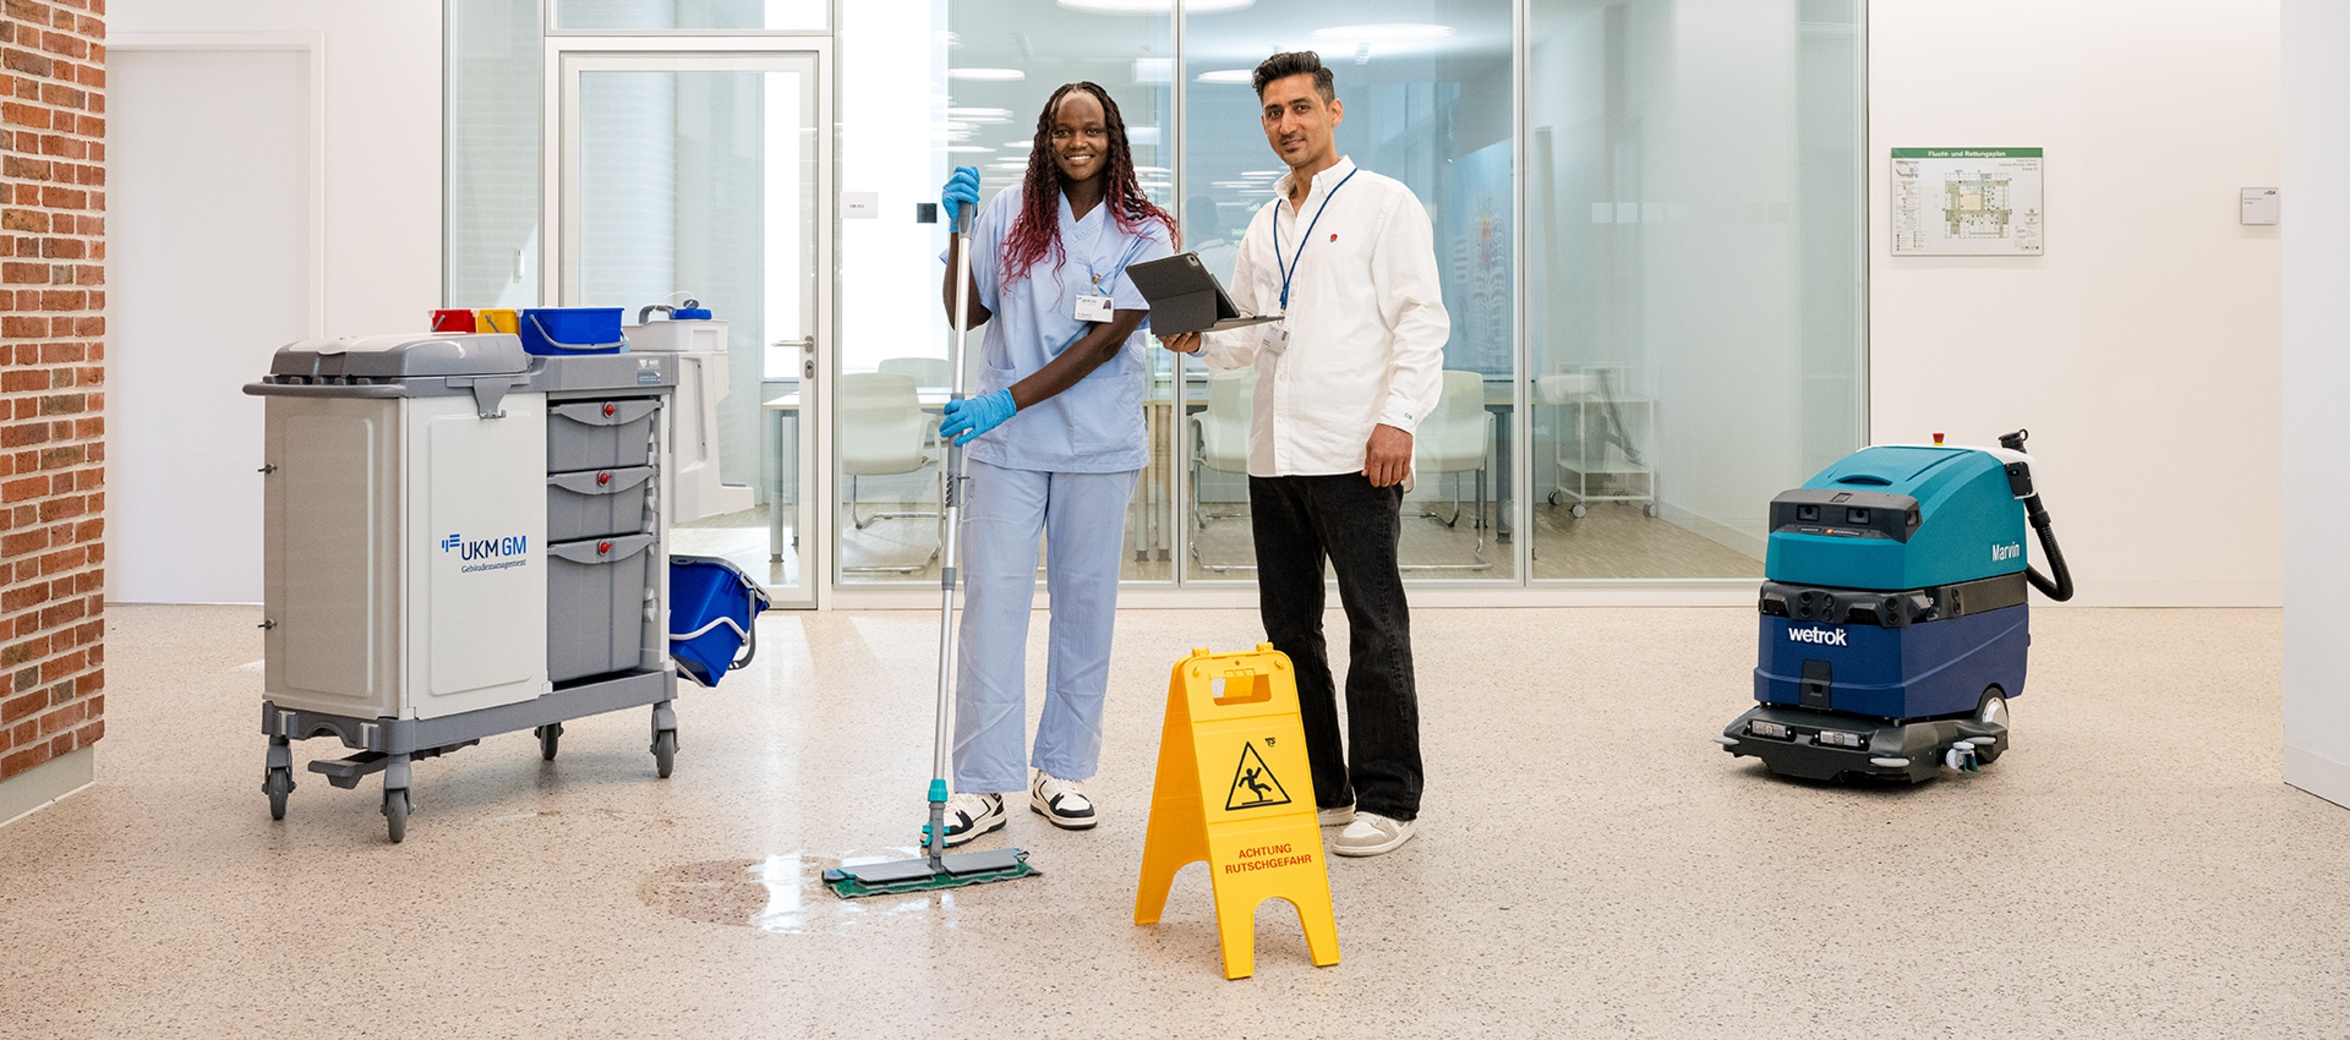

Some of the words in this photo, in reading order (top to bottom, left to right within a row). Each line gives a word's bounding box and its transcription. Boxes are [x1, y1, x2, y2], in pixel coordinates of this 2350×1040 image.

[1964, 150, 2006, 159] Rettungsplan
[461, 538, 498, 561] UKM
[502, 535, 526, 556] GM
[1992, 541, 2020, 562] Marvin
[461, 559, 526, 573] Gebäudemanagement
[1788, 626, 1847, 647] wetrok
[1238, 843, 1292, 859] ACHTUNG
[1225, 854, 1312, 874] RUTSCHGEFAHR
